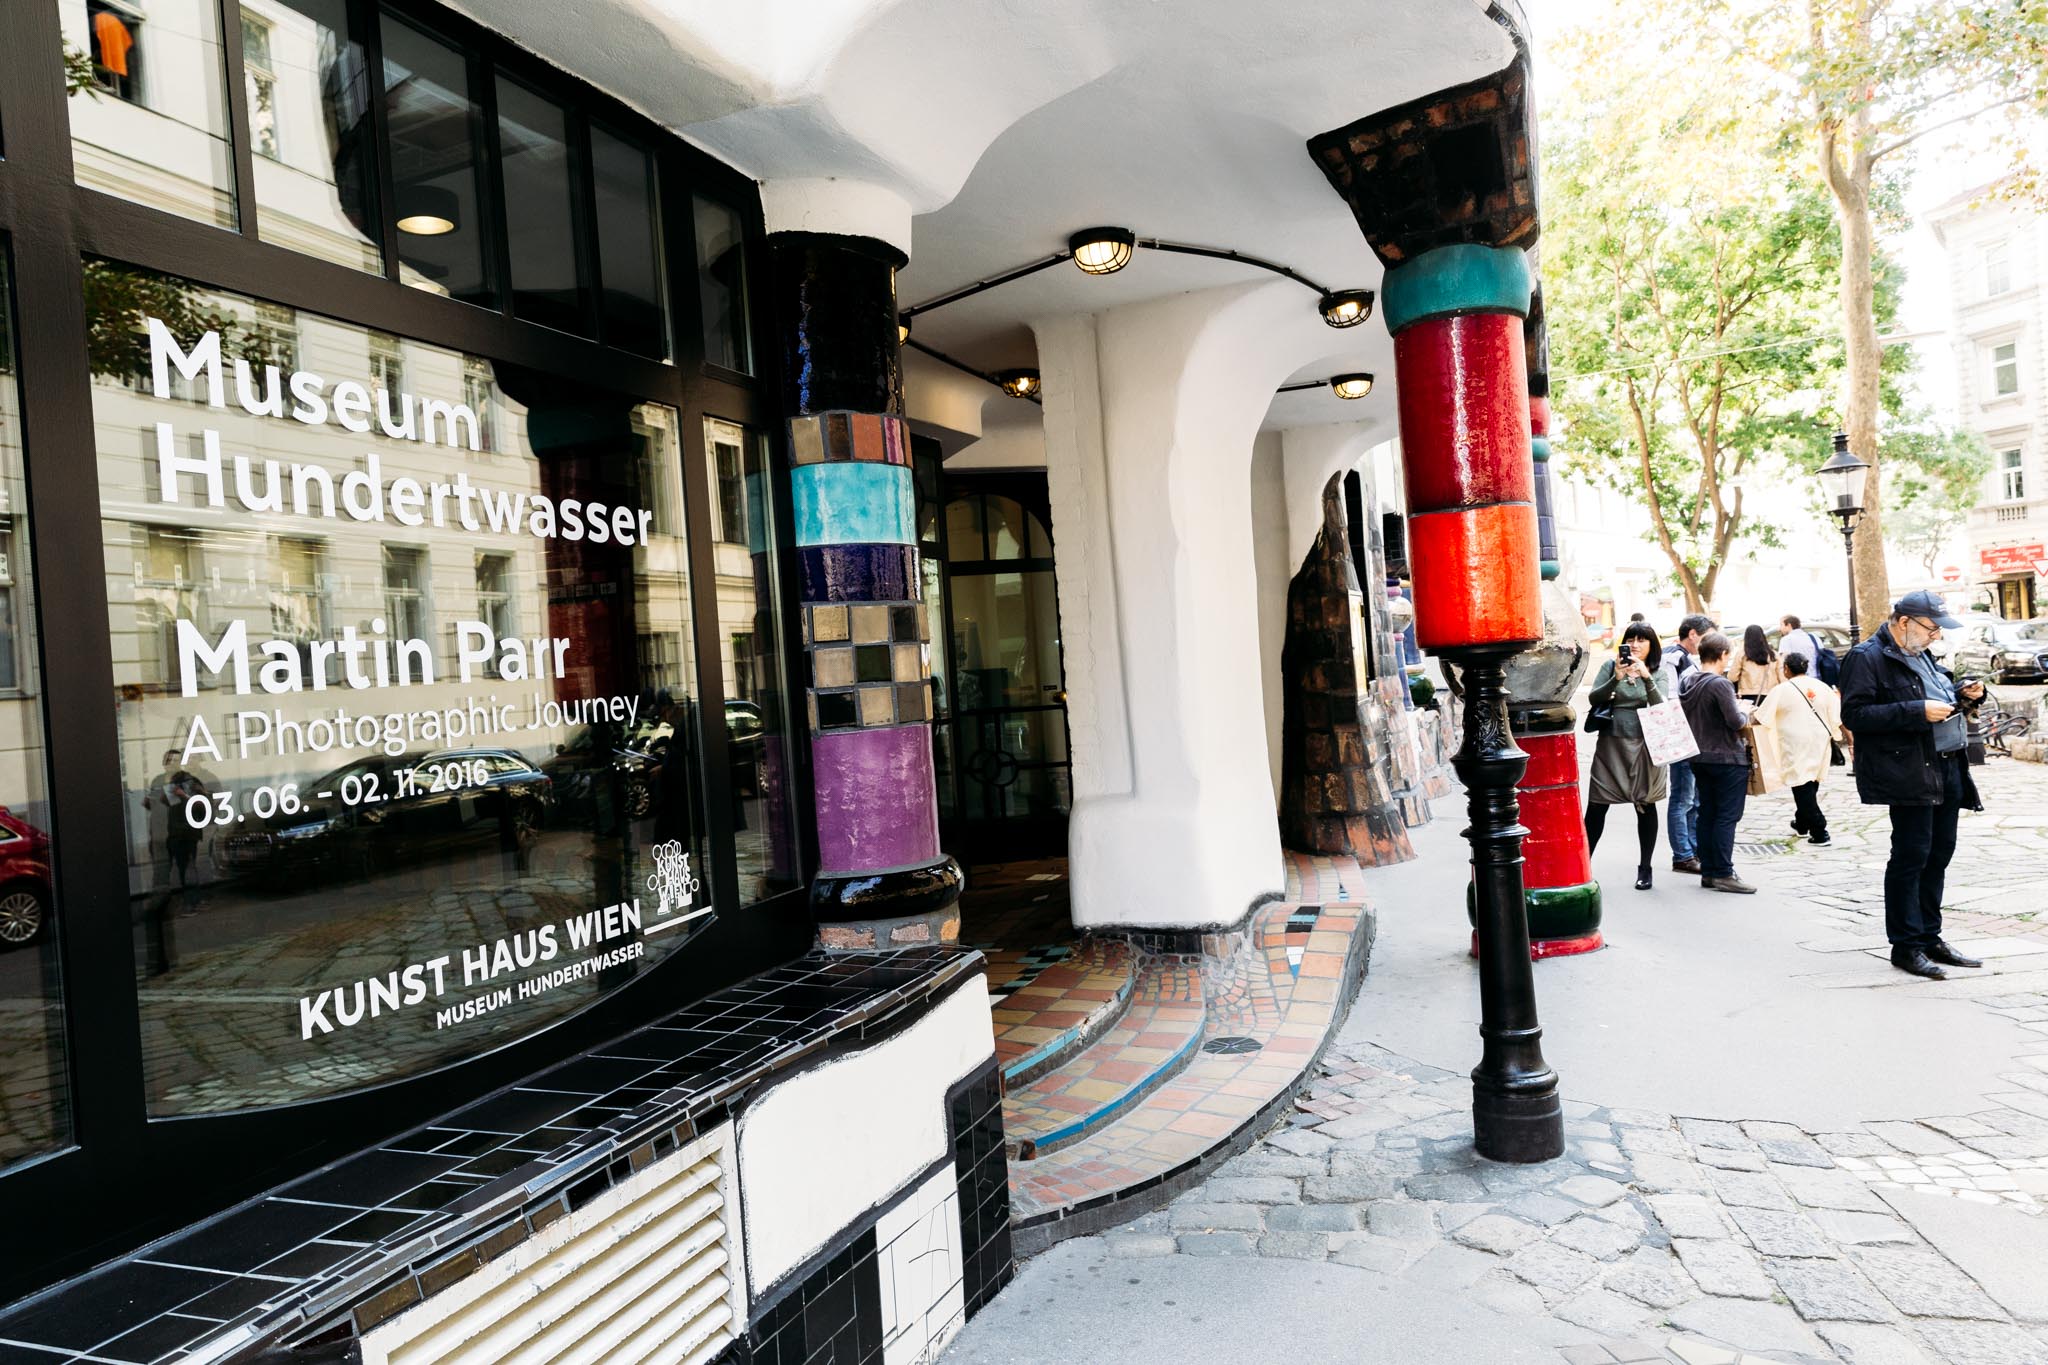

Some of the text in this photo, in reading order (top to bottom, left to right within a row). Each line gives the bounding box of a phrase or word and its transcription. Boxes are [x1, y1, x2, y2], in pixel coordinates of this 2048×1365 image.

[148, 317, 480, 452] Museum
[156, 422, 653, 547] Hundertwasser
[177, 618, 570, 698] Martin Parr
[181, 689, 639, 765] A Photographic Journey
[300, 899, 643, 1040] KUNST HAUS WIEN
[437, 942, 644, 1030] MUSEUM HUNDERTWASSER
